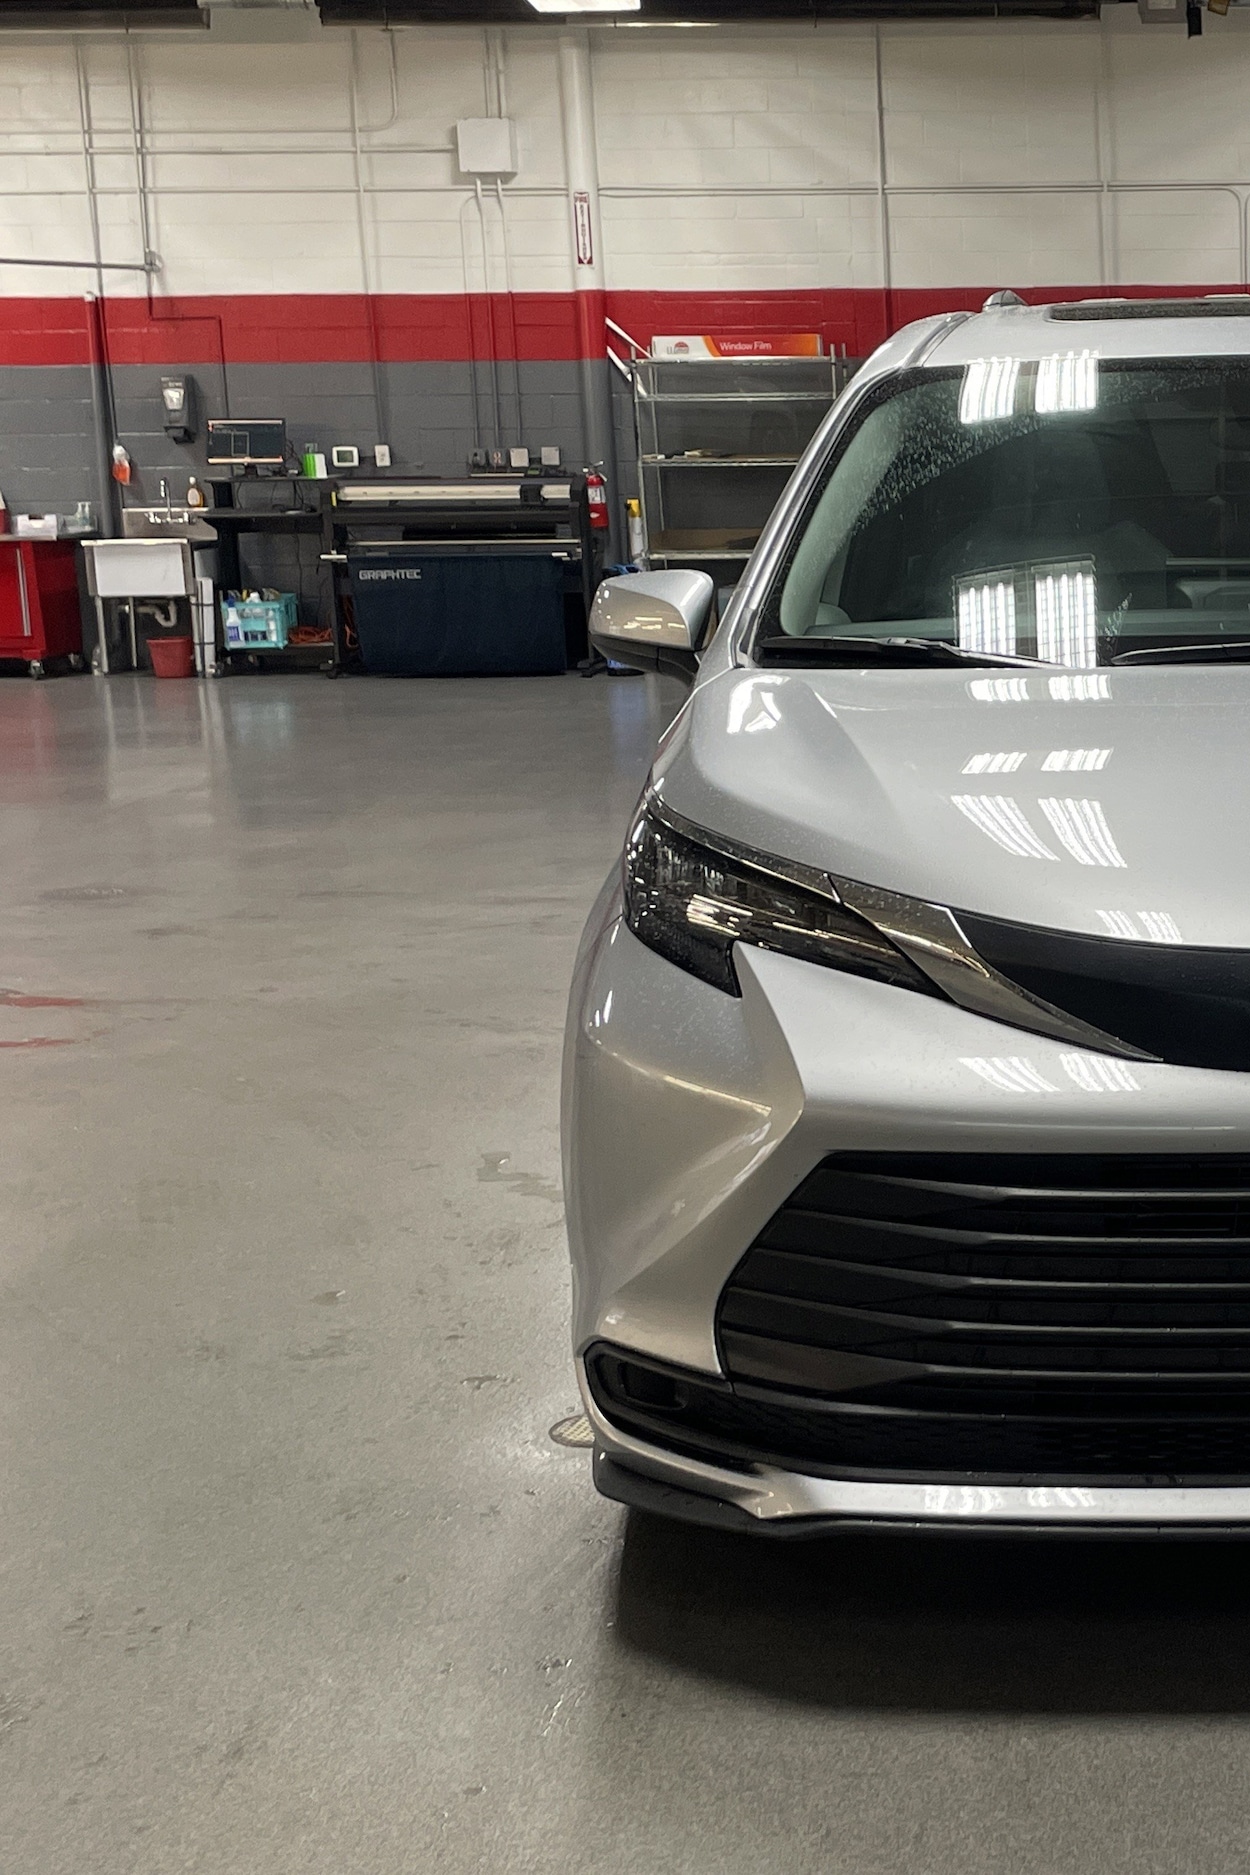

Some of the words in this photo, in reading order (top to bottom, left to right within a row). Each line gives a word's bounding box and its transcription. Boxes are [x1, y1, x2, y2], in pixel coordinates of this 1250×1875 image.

[720, 342, 753, 351] Window
[754, 340, 772, 350] Film
[359, 569, 421, 580] GRAPHTEC
